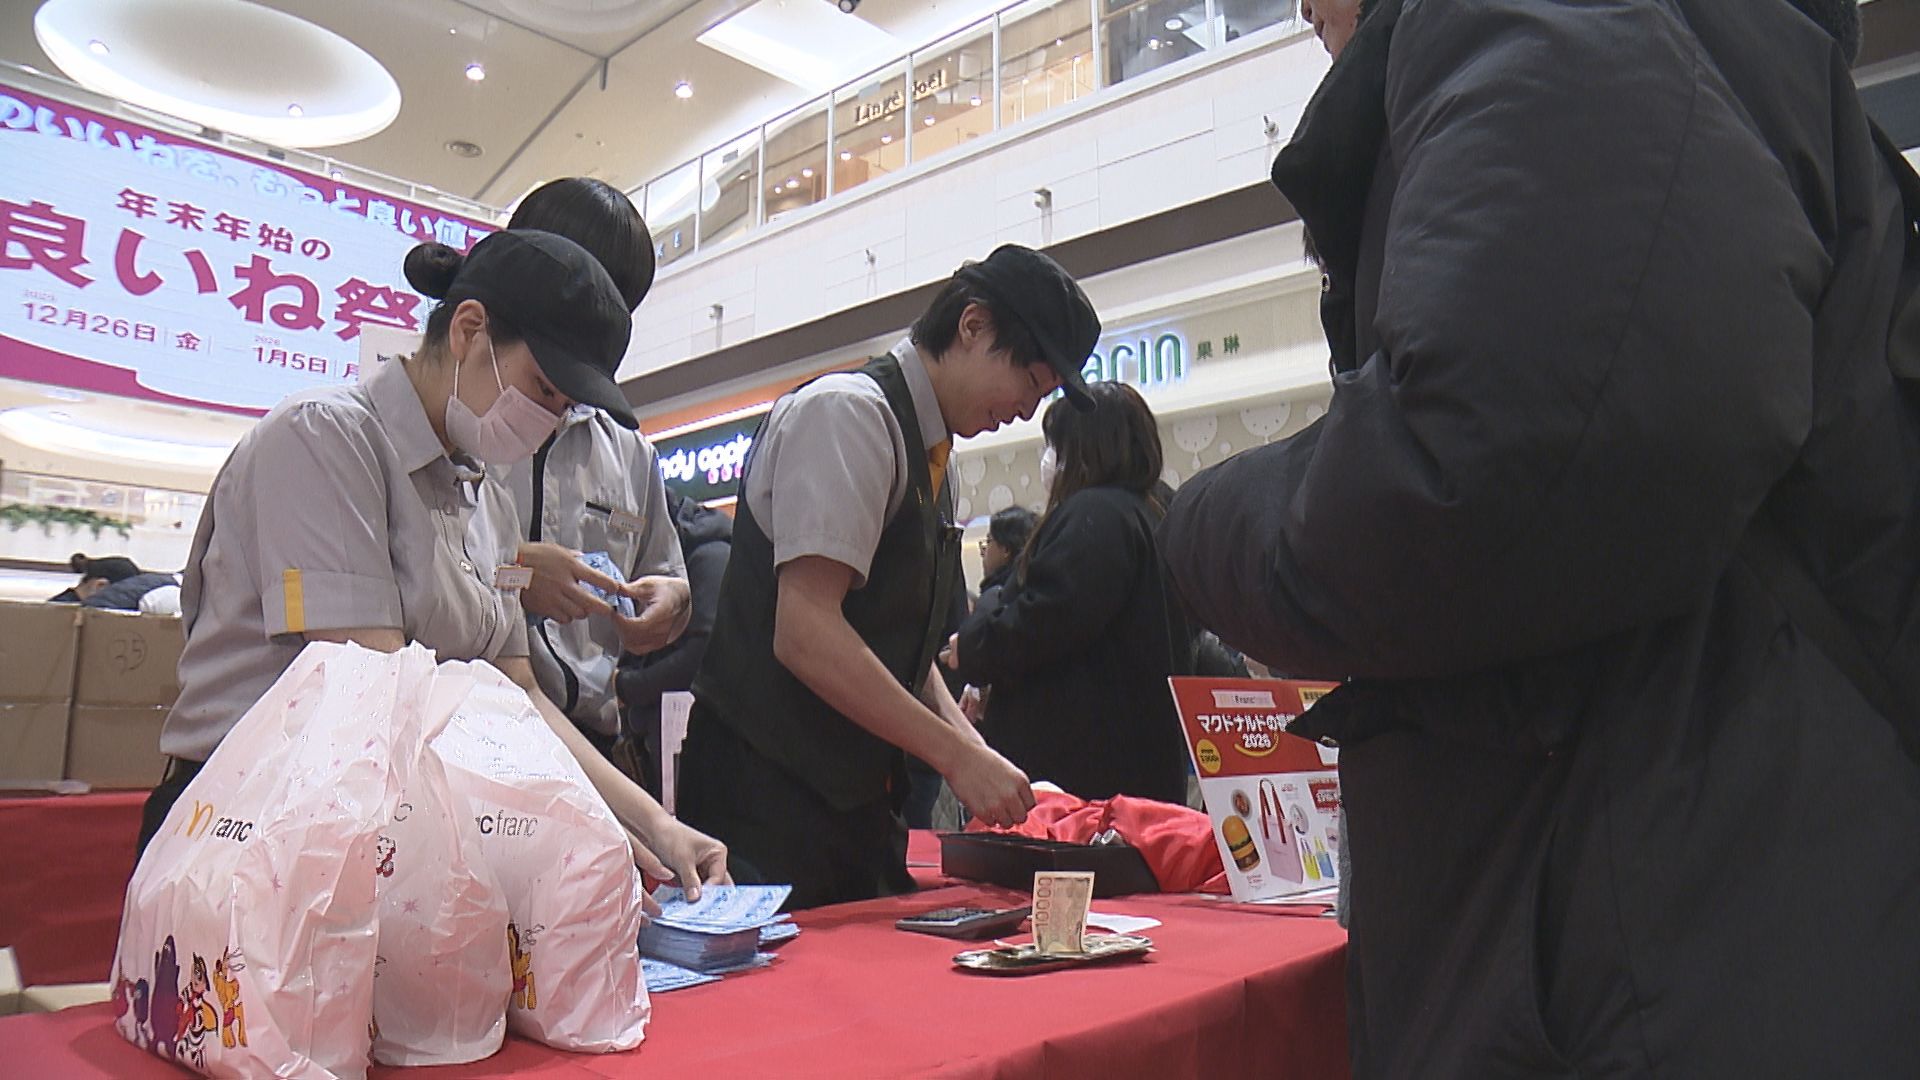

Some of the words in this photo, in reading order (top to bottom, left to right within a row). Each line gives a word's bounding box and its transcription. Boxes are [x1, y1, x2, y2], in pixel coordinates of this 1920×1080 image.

[116, 187, 331, 261] 年末年始の
[0, 199, 422, 342] 良いね祭
[23, 302, 156, 342] 12月26日
[176, 331, 201, 352] 金
[253, 346, 327, 374] 1月5日
[1035, 876, 1053, 928] 10000
